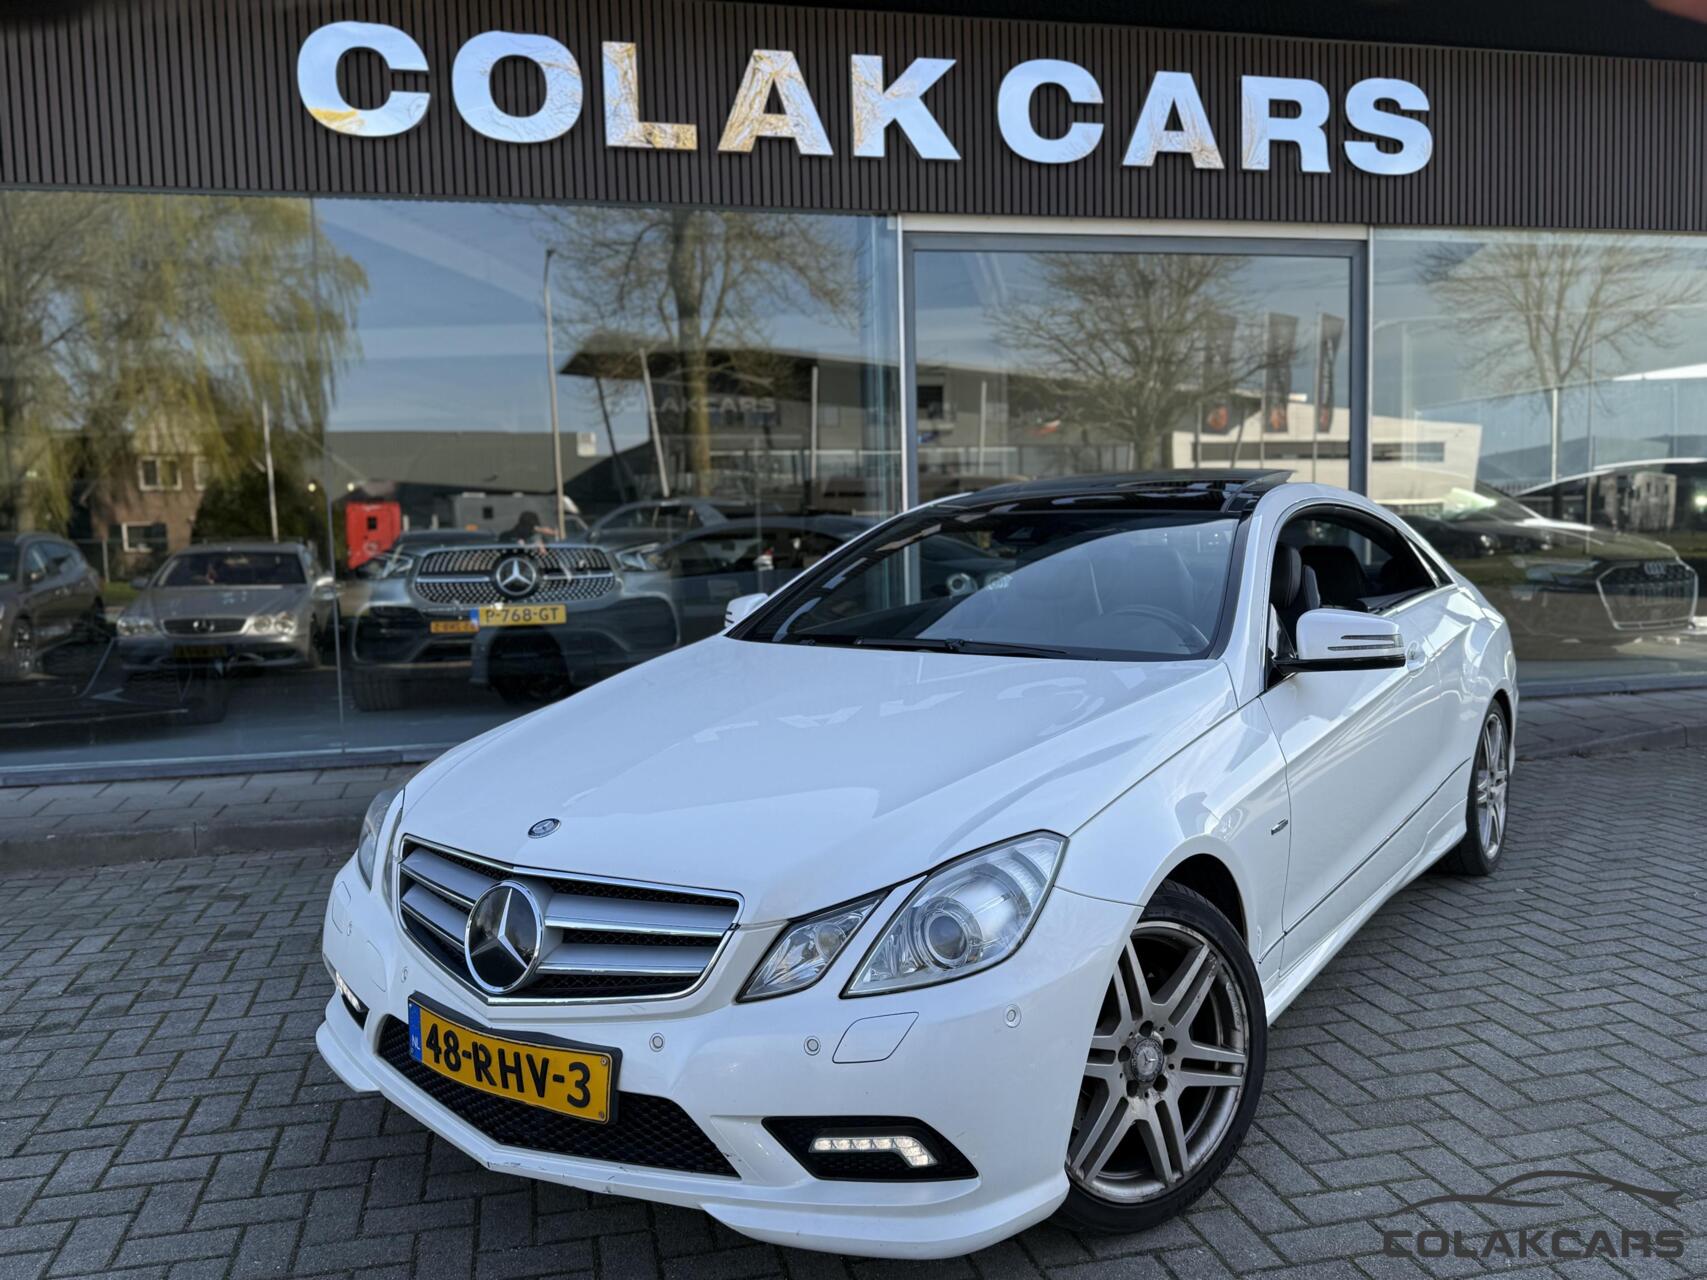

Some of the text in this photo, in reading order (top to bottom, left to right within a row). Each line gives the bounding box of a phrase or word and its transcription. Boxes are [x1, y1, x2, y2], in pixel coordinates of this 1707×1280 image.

[297, 20, 1433, 176] COLAK CARS
[485, 607, 559, 623] P-768-GT
[426, 1023, 591, 1108] 48-RHV-3
